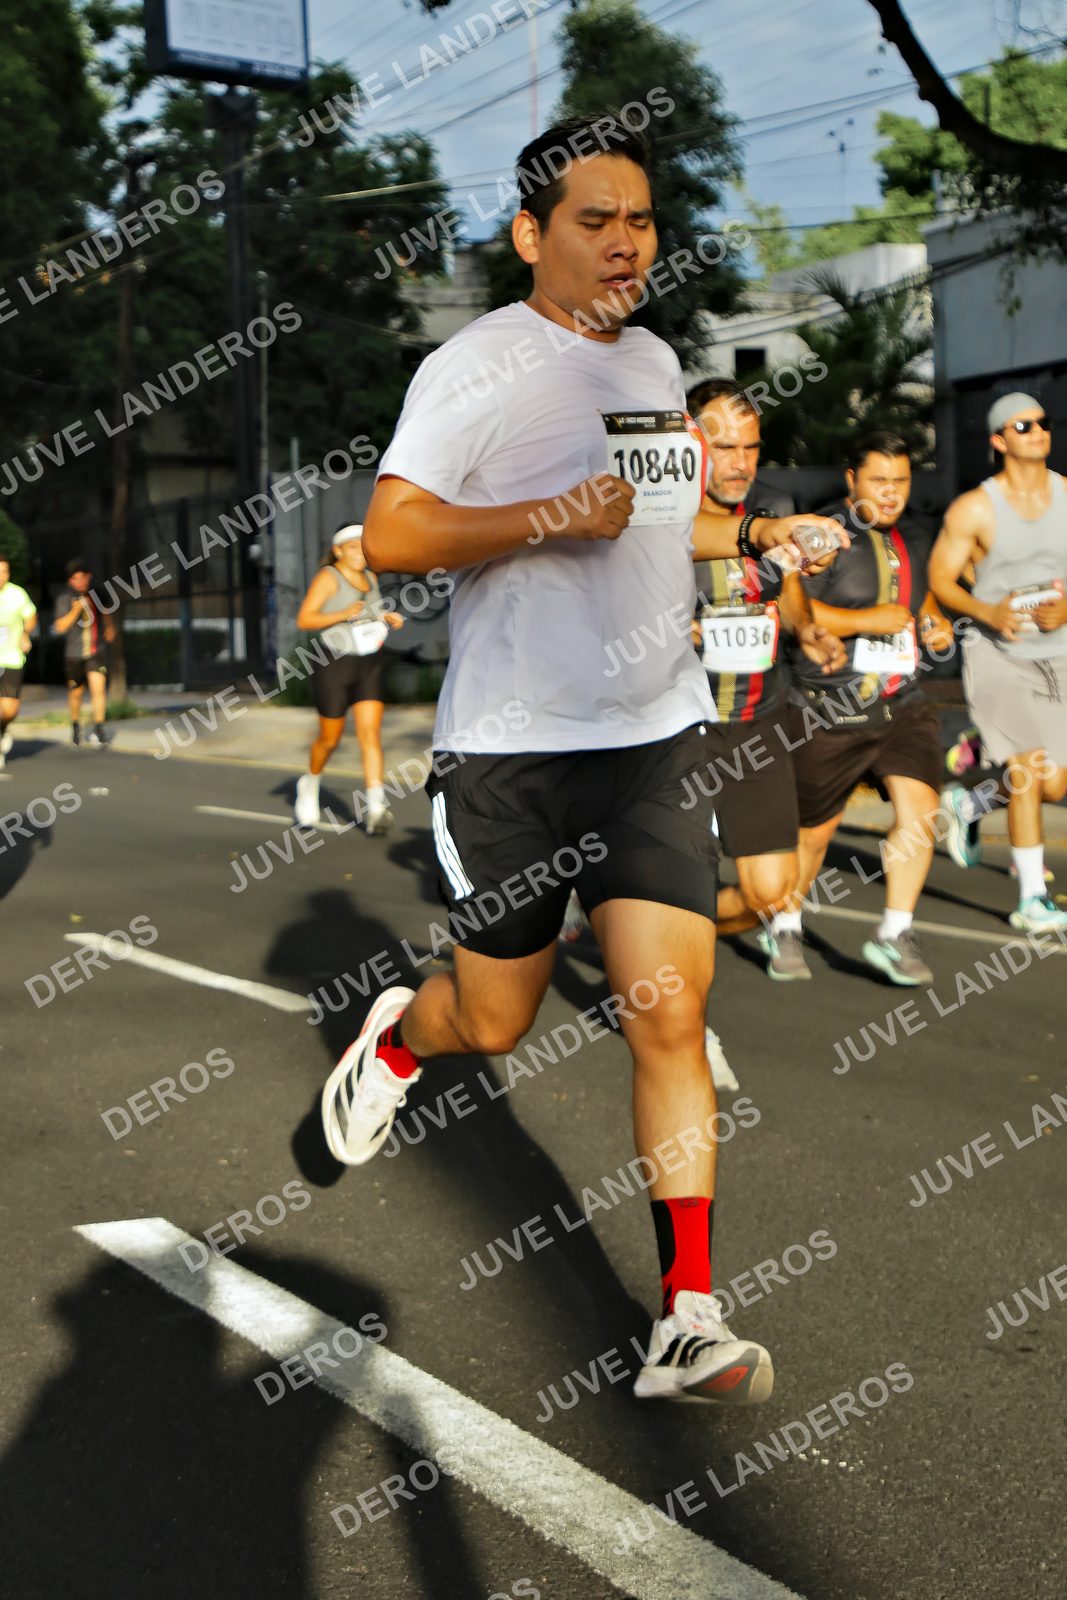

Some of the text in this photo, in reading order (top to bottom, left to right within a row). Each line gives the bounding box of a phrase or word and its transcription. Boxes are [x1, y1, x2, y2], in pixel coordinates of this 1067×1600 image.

[614, 447, 696, 484] 10840
[643, 489, 672, 497] BRANDON
[709, 625, 771, 649] 11036
